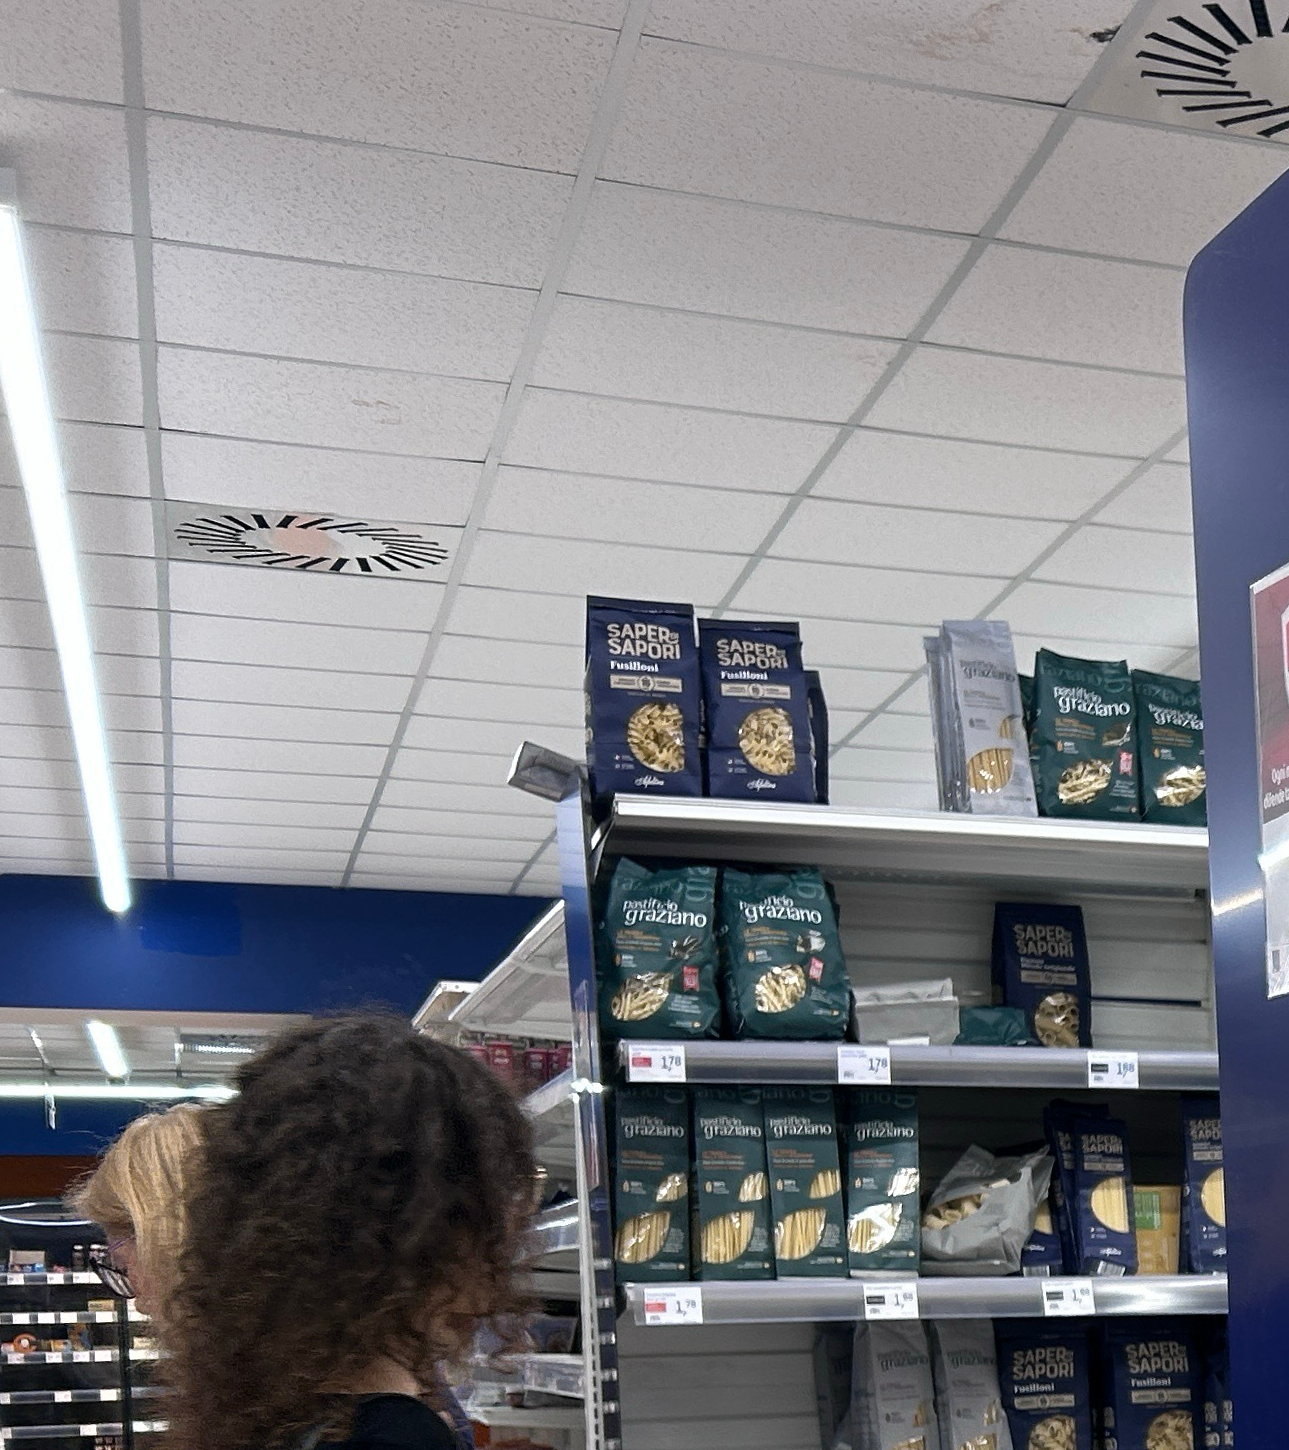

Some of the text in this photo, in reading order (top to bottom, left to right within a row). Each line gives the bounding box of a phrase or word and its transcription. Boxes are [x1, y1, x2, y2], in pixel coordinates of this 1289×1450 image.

[607, 623, 670, 642] SAPER
[608, 638, 680, 660] SAPORI
[717, 639, 778, 657] SAPER
[718, 653, 788, 669] SAPORI
[1058, 696, 1129, 717] graziano
[625, 909, 706, 928] graziano
[745, 905, 821, 925] graziano
[1013, 924, 1064, 941] SAPER
[1015, 940, 1073, 958] SAPORI
[1014, 1347, 1066, 1365] SAPER
[1126, 1341, 1179, 1359] SAPER
[1013, 1363, 1073, 1381] SAPORI
[1128, 1357, 1189, 1374] SAPORI
